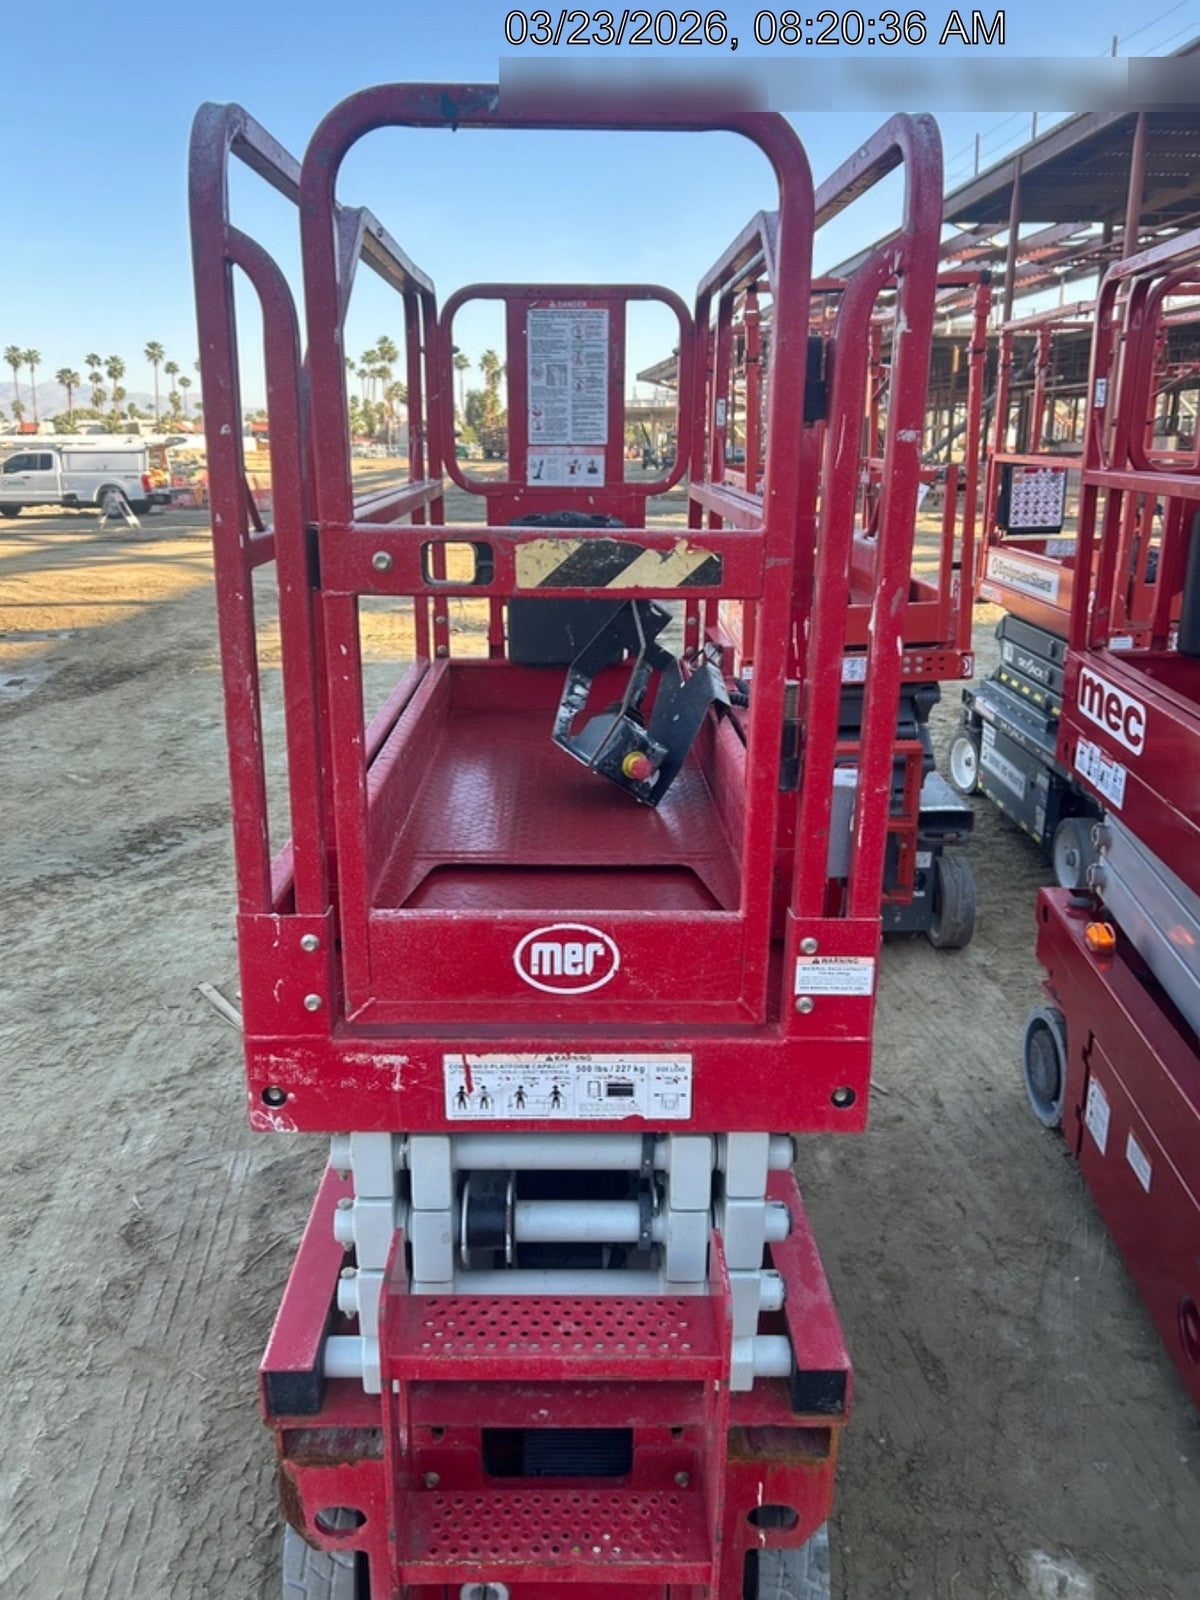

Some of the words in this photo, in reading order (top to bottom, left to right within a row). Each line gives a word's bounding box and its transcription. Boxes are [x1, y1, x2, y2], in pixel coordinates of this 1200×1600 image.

[1080, 673, 1143, 748] mec
[575, 1064, 592, 1073] 500
[594, 1064, 608, 1073] lbs
[615, 1064, 632, 1073] 227
[633, 1064, 646, 1075] kg
